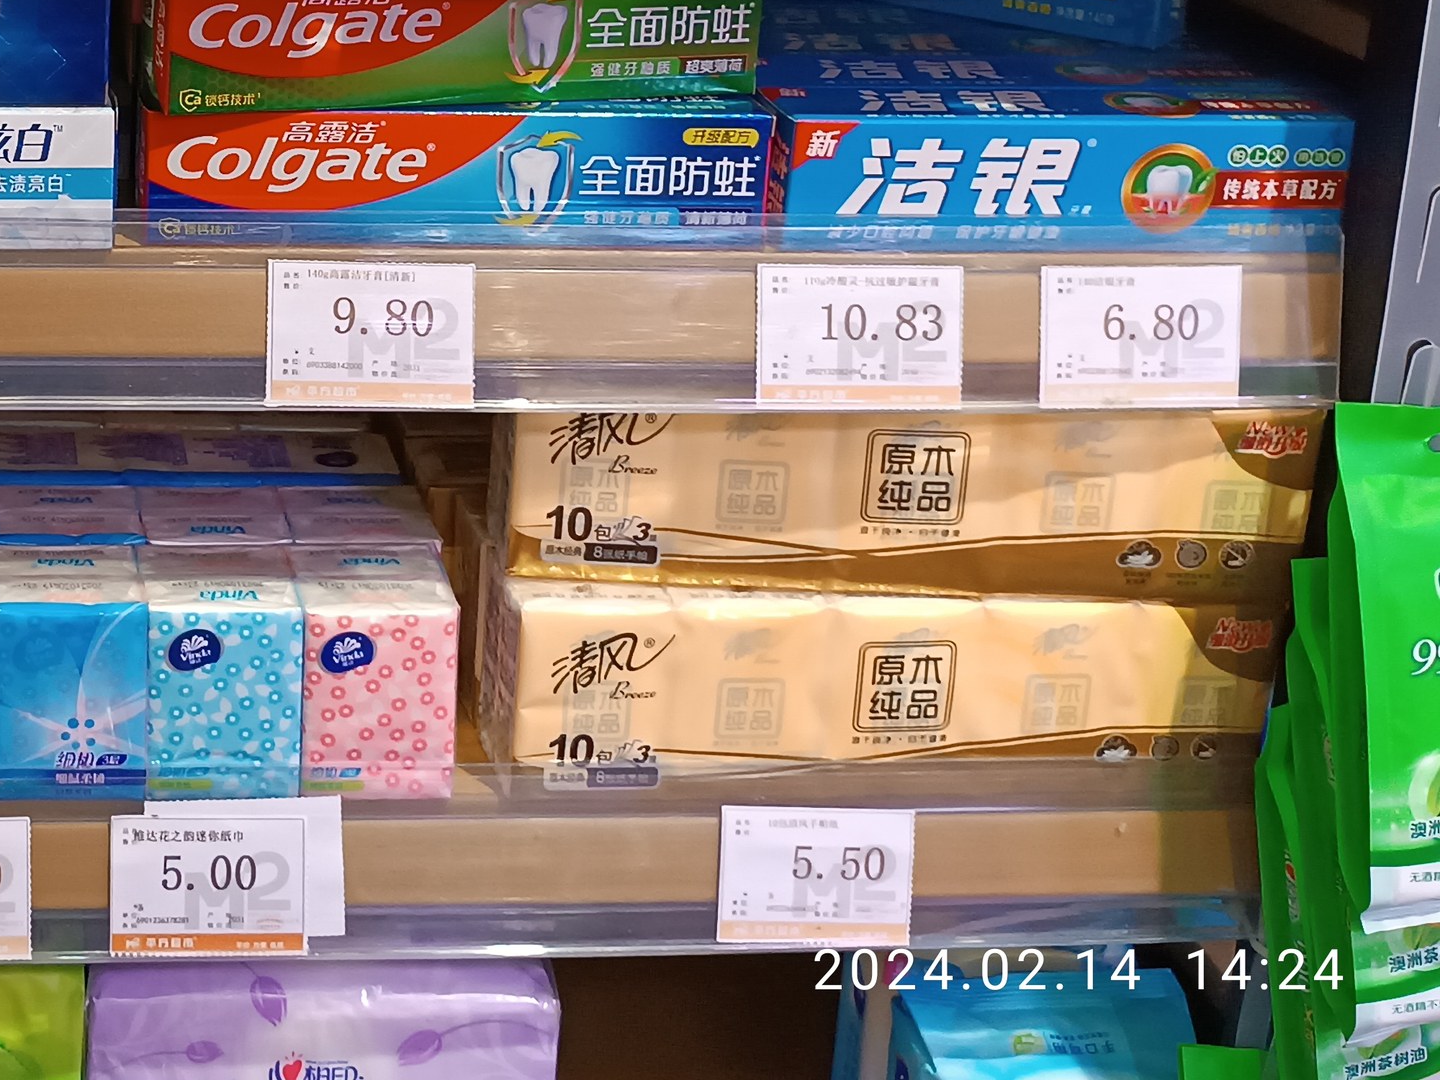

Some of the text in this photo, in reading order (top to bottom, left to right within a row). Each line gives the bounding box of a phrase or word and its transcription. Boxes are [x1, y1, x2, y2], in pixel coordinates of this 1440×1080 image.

[188, 1, 444, 59] Colgate
[586, 5, 752, 50] 全面防蛀
[282, 121, 376, 144] 高露洁
[804, 129, 838, 158] 新
[166, 134, 430, 194] Colgate
[578, 155, 756, 199] 全面防蛀
[835, 137, 1083, 217] 洁银
[1221, 177, 1338, 203] 传统本草配方
[332, 296, 434, 337] 9.80
[820, 303, 944, 342] 10.83
[1103, 303, 1200, 341] 6.80
[548, 413, 676, 465] 清风
[607, 454, 658, 476] Breeze
[880, 442, 958, 477] 原木
[877, 480, 953, 513] 纯品
[550, 631, 676, 695] 清风
[871, 654, 944, 686] 原木
[609, 680, 657, 701] Breeze
[868, 688, 940, 721] 纯品
[161, 854, 257, 891] 5.00
[792, 845, 886, 881] 5.50
